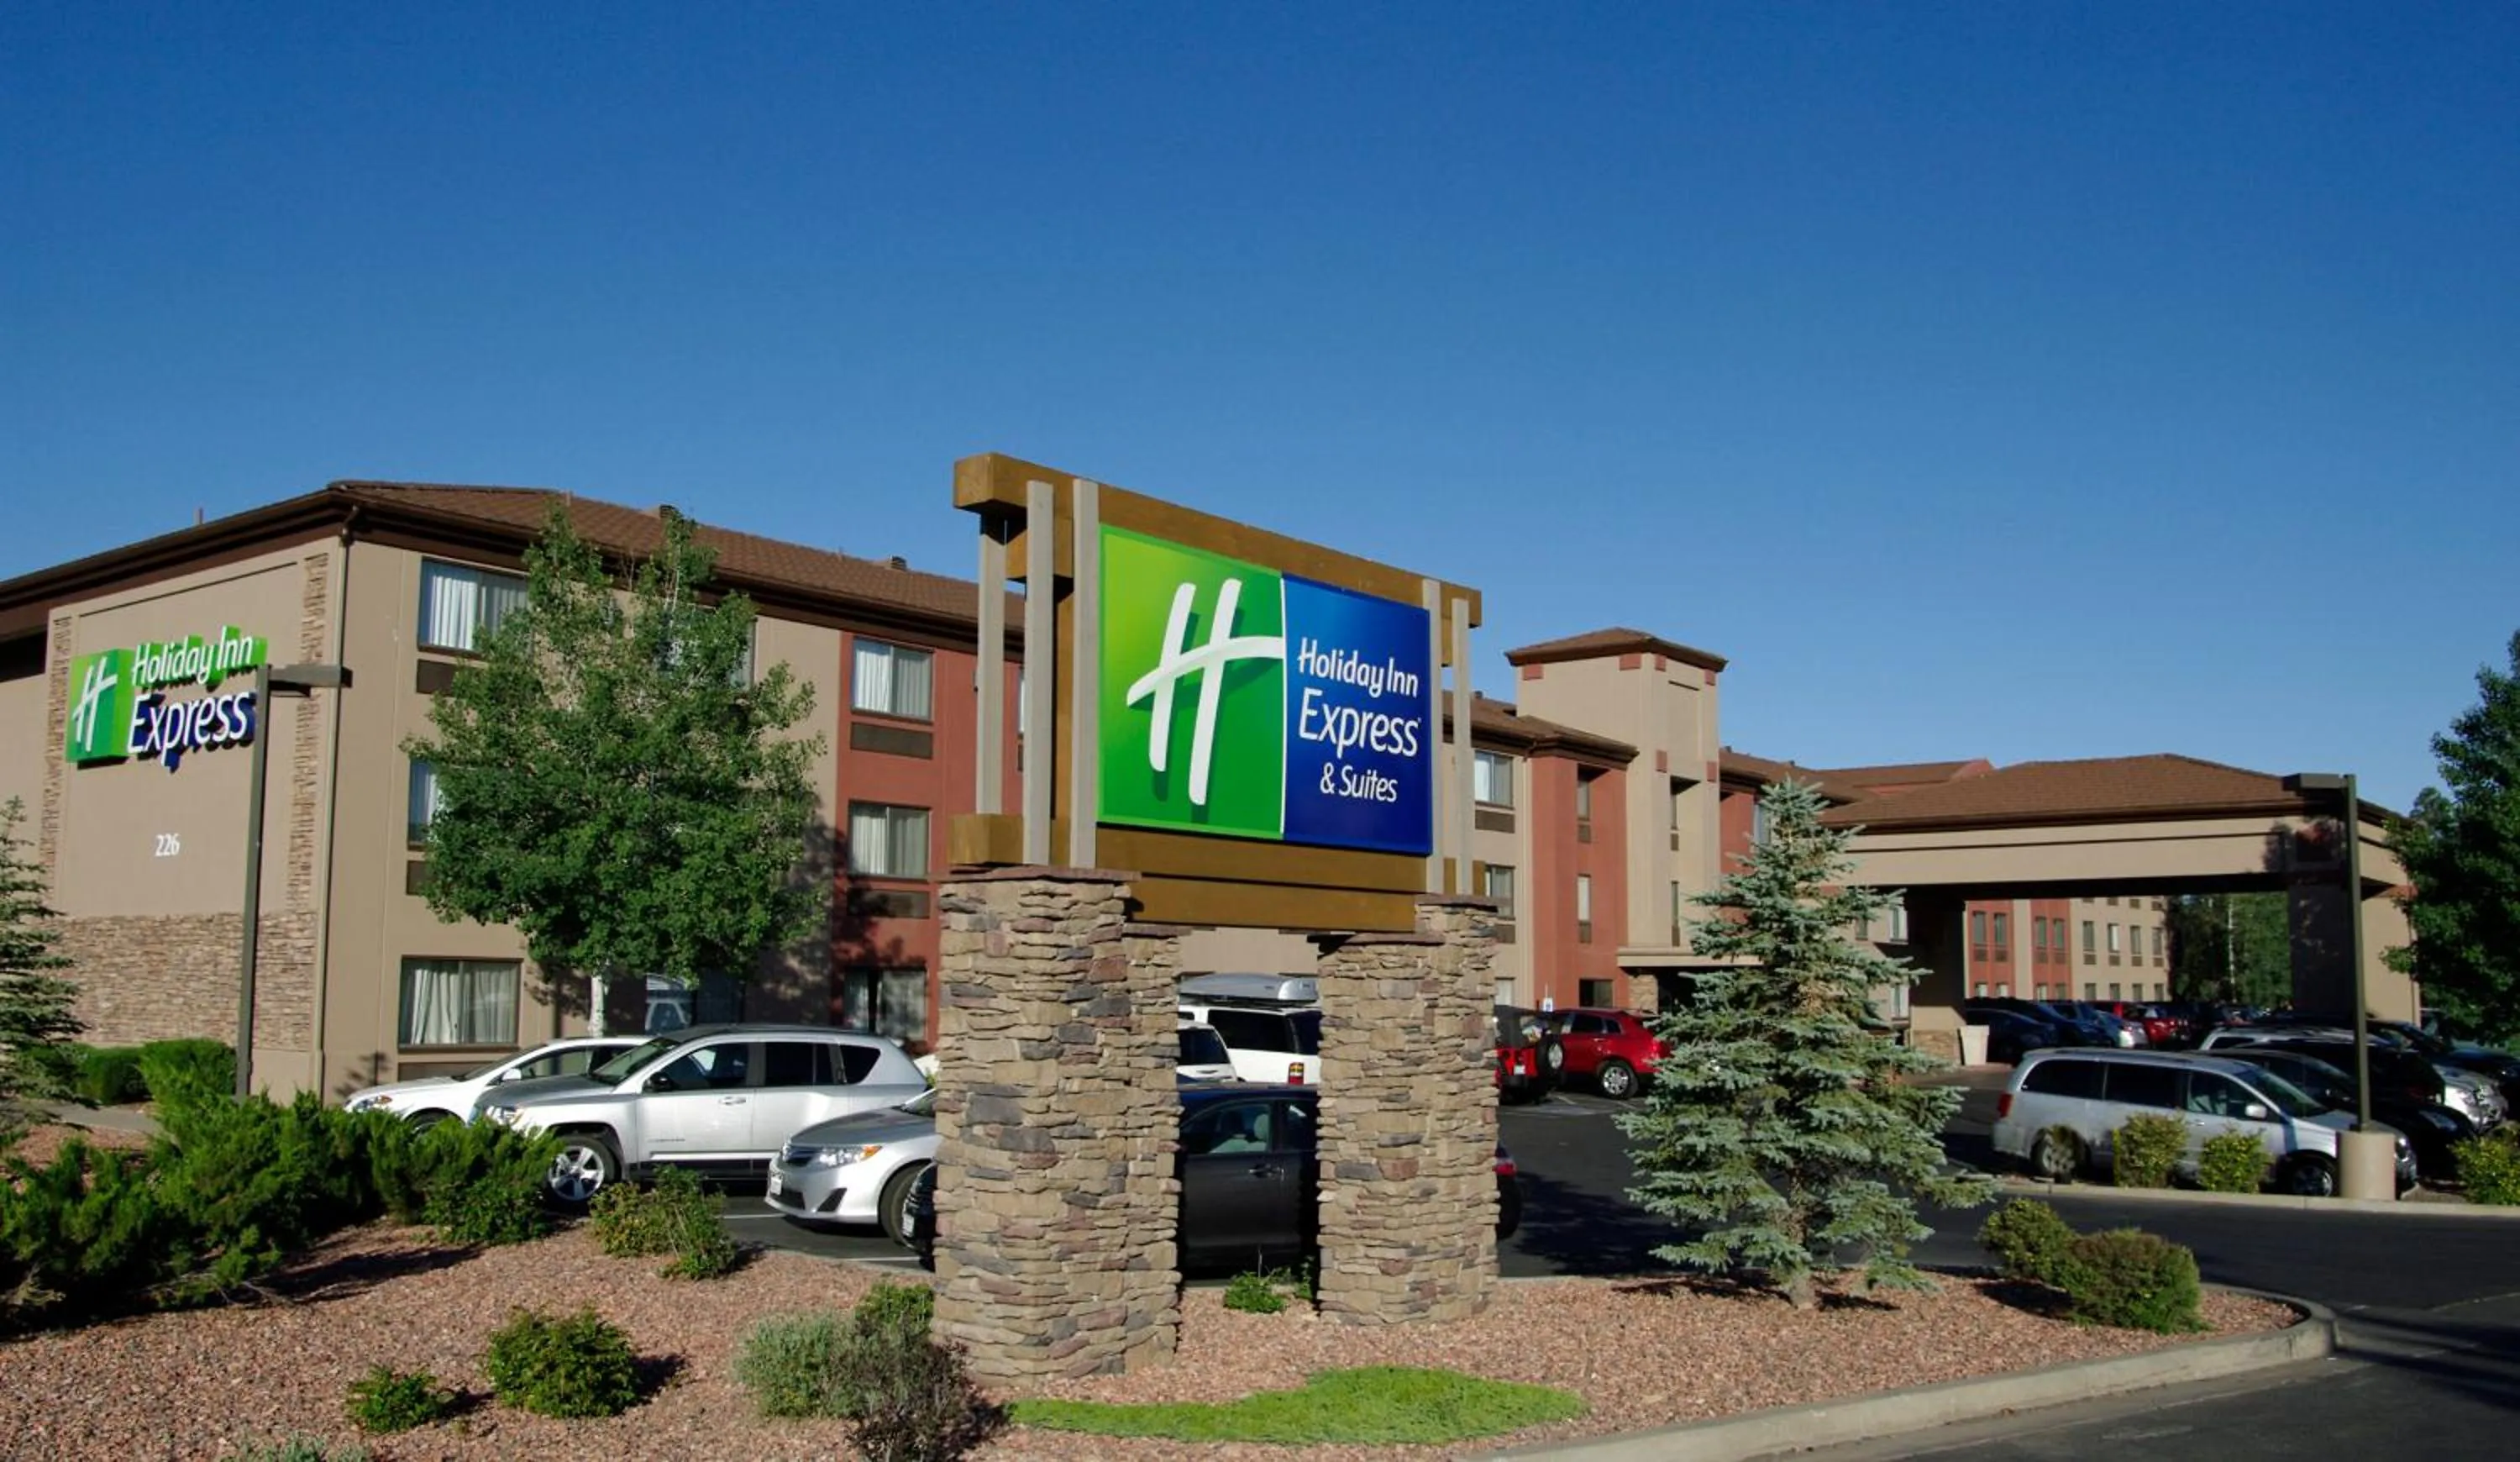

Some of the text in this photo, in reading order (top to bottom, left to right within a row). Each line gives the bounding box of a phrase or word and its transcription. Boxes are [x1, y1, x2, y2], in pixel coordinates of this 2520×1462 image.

[132, 625, 253, 686] Holiday Inn
[1297, 637, 1419, 698] Holiday Inn
[72, 656, 118, 754] H
[1126, 577, 1284, 806] H
[1299, 686, 1420, 760] Express
[127, 692, 249, 766] Express
[1320, 762, 1398, 802] & Suites
[155, 834, 180, 856] 226
